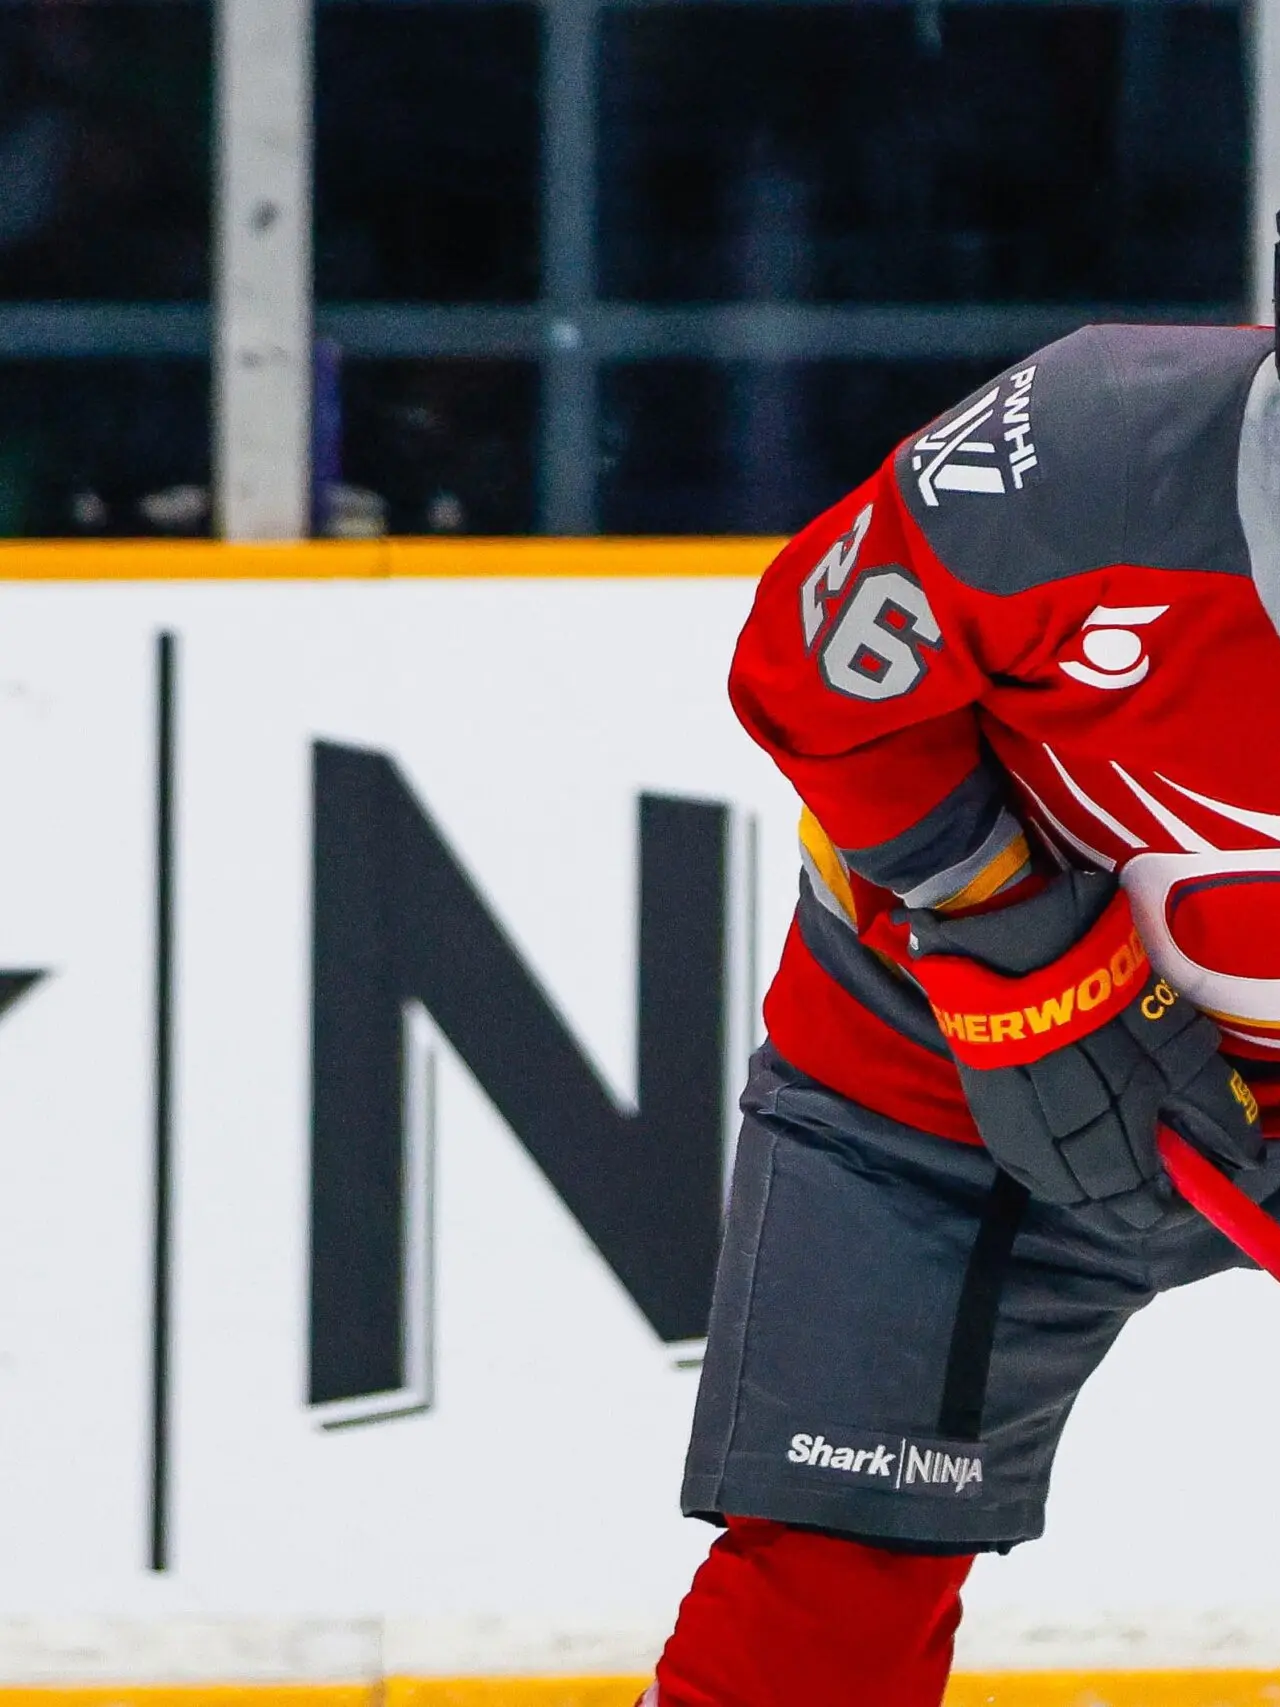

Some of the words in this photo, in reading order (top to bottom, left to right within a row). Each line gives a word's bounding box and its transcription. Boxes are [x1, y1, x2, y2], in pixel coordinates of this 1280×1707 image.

[1001, 364, 1039, 490] PWHL
[801, 502, 946, 703] 26
[1141, 978, 1179, 1020] CO
[787, 1433, 897, 1477] Shark
[904, 1444, 984, 1494] NINJA
